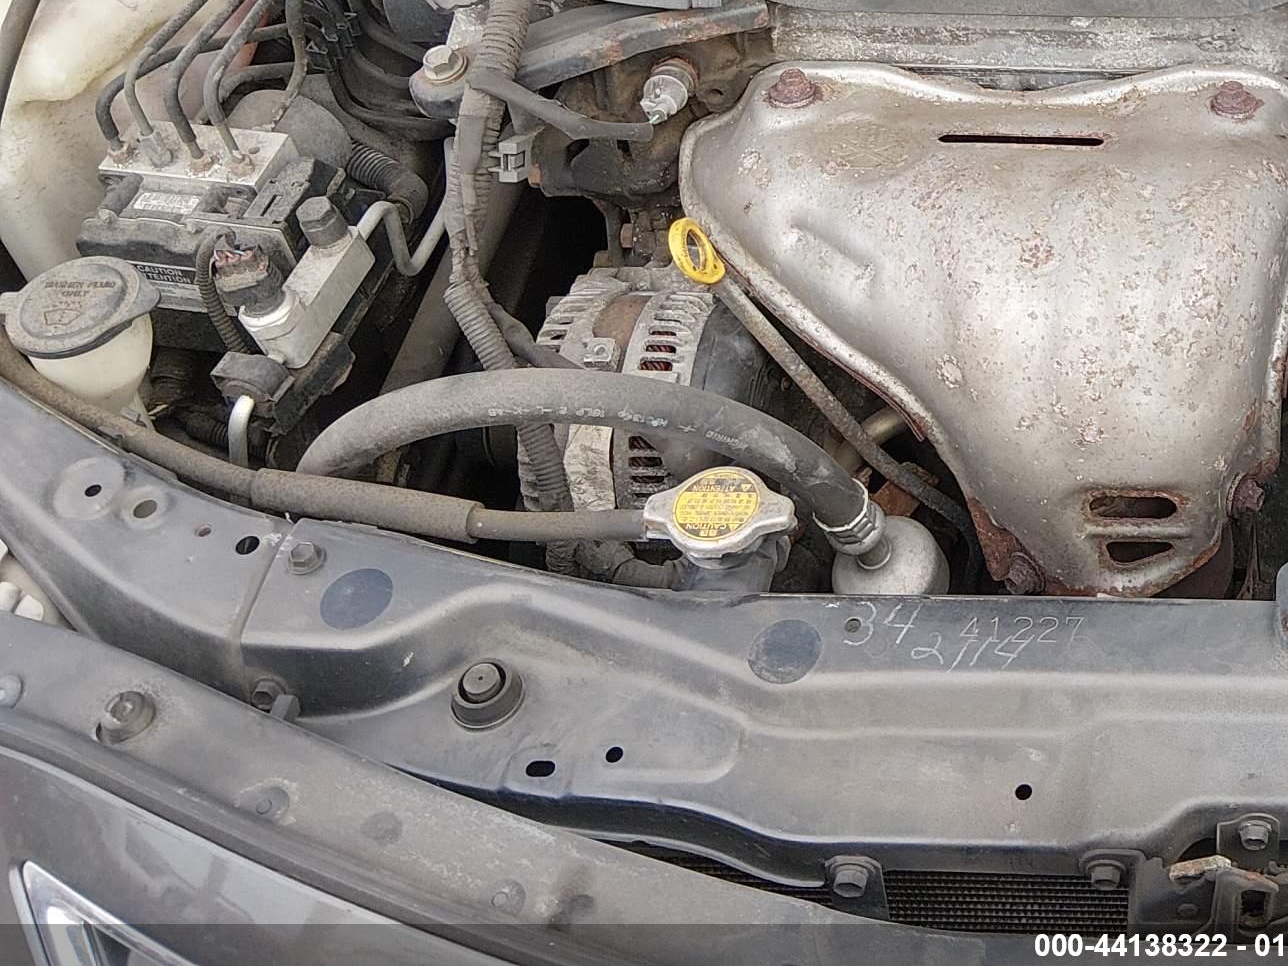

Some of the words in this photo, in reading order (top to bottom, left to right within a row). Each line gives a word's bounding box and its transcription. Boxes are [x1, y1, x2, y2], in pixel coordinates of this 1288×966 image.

[136, 265, 183, 277] CAUTION
[144, 272, 192, 285] TENTION
[685, 523, 727, 531] CAUTION
